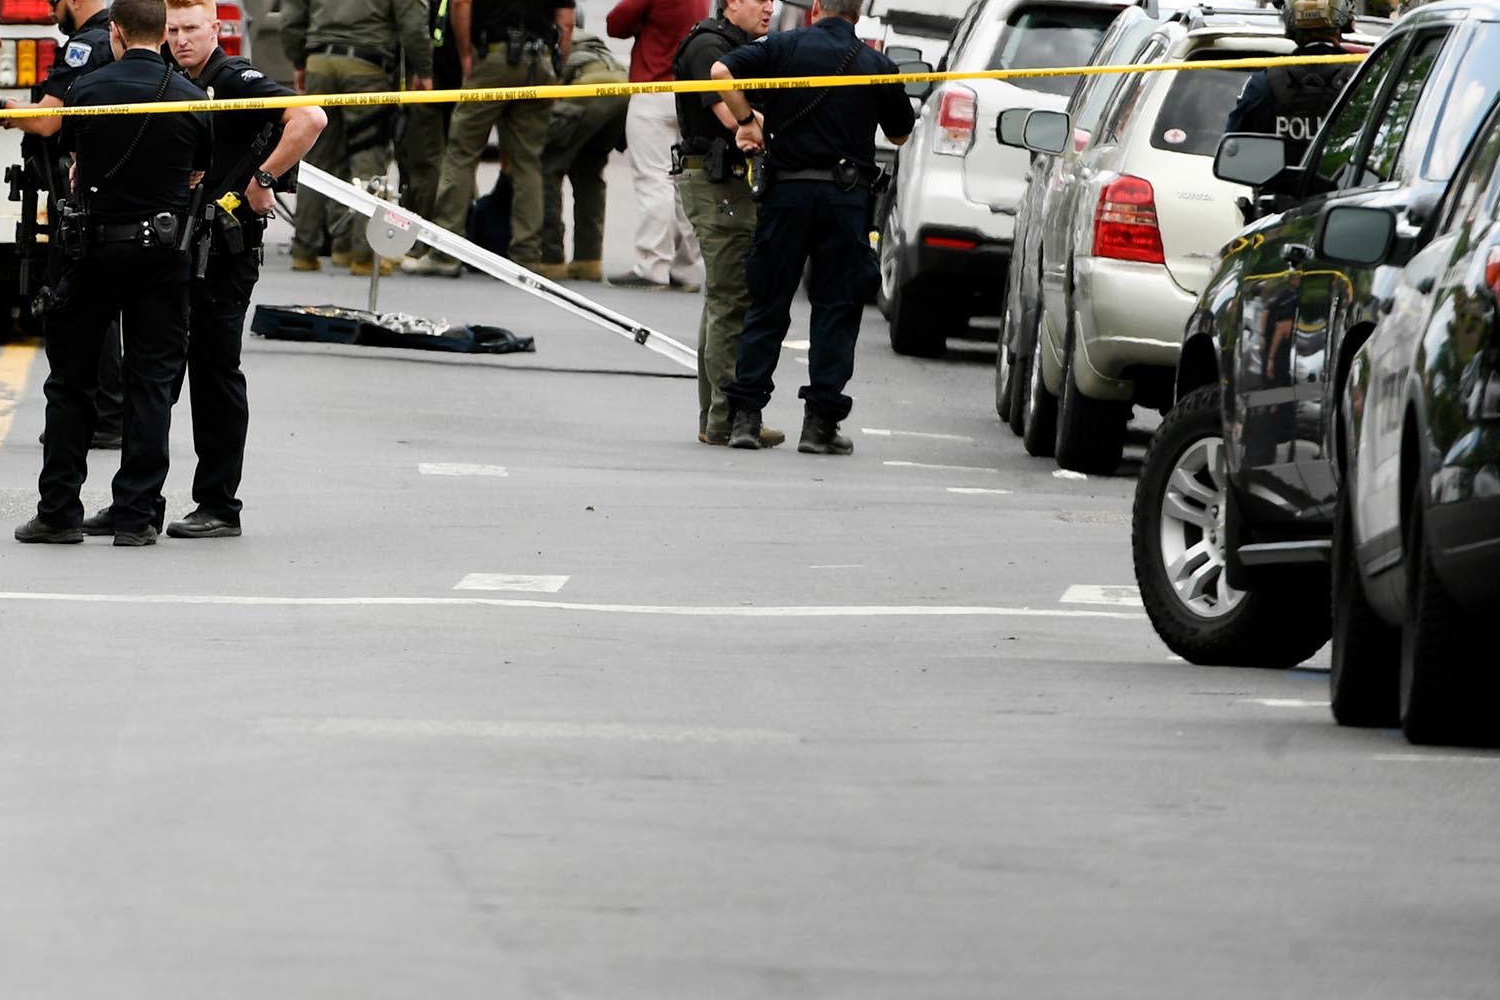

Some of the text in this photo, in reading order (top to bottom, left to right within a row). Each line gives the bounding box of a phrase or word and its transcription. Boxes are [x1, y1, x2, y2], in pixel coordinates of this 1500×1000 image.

[345, 96, 357, 104] LINE
[382, 95, 400, 103] CROSS
[481, 92, 494, 100] LINE
[505, 91, 516, 99] NOT
[518, 90, 537, 98] CROSS
[1276, 115, 1322, 141] POLI
